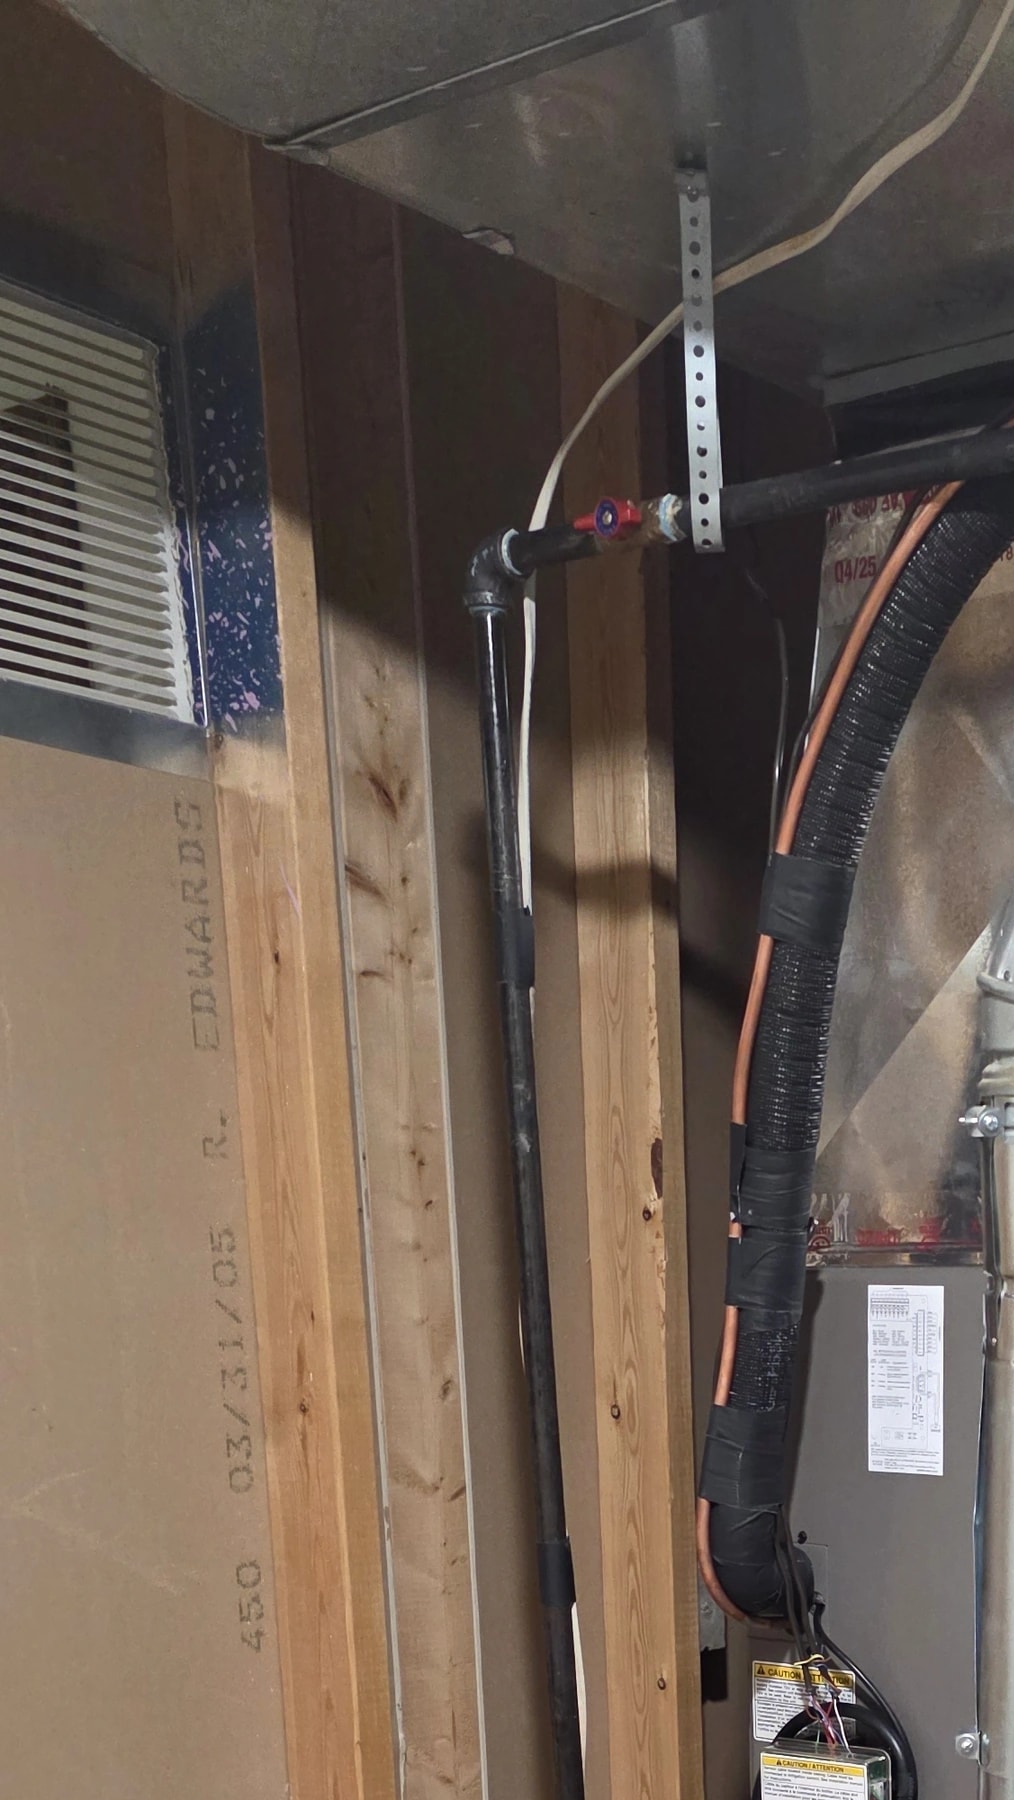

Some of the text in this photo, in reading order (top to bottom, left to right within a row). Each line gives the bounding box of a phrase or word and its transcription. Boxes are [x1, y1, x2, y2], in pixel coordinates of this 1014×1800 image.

[173, 799, 222, 1052] EDWARDS
[210, 1223, 256, 1494] 03/31/05
[235, 1558, 265, 1654] 450
[768, 1669, 801, 1679] CAUTION
[783, 1760, 844, 1772] CAUTION ATTENTION
